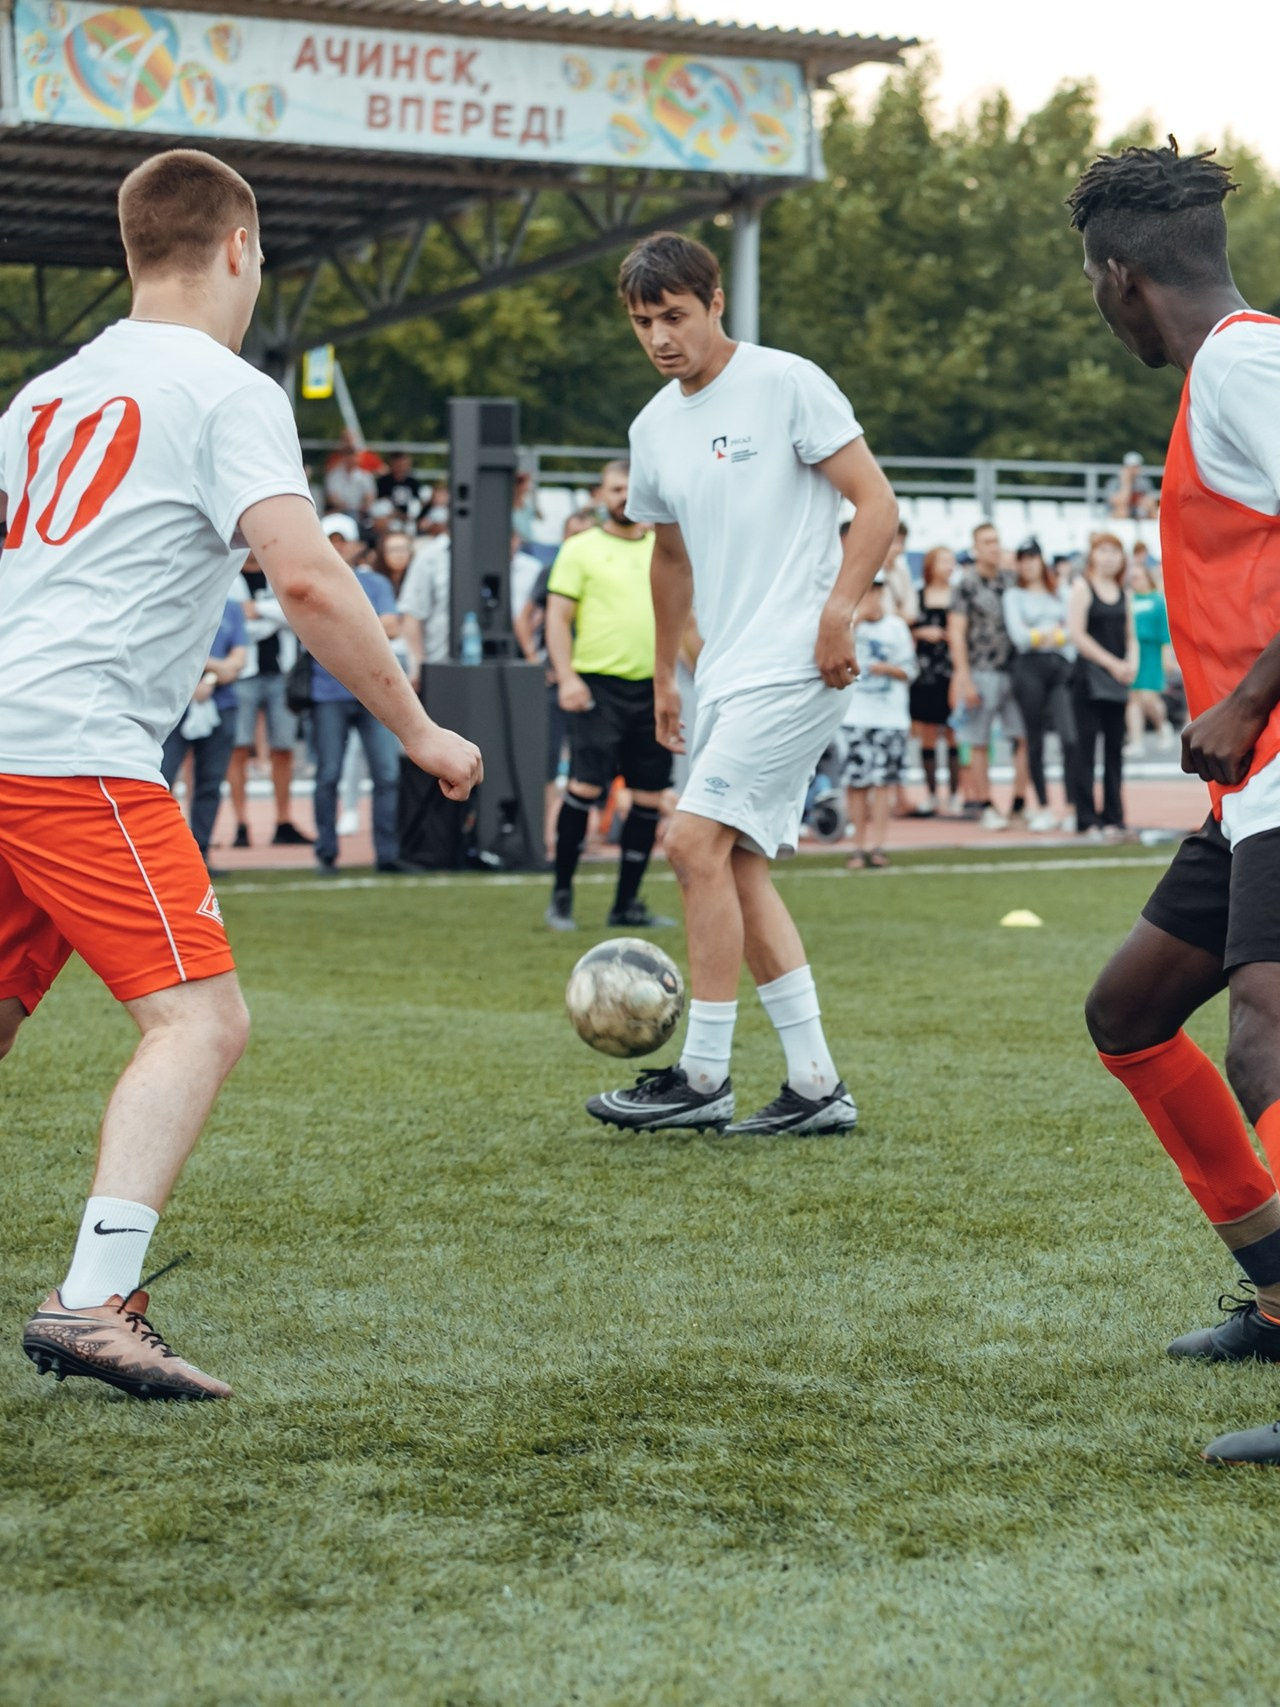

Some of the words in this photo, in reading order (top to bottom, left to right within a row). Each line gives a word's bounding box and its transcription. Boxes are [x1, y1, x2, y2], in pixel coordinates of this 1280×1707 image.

[294, 35, 490, 95] АЧИНСК,
[367, 94, 565, 147] ВПЕРЕД!
[3, 395, 141, 549] 10
